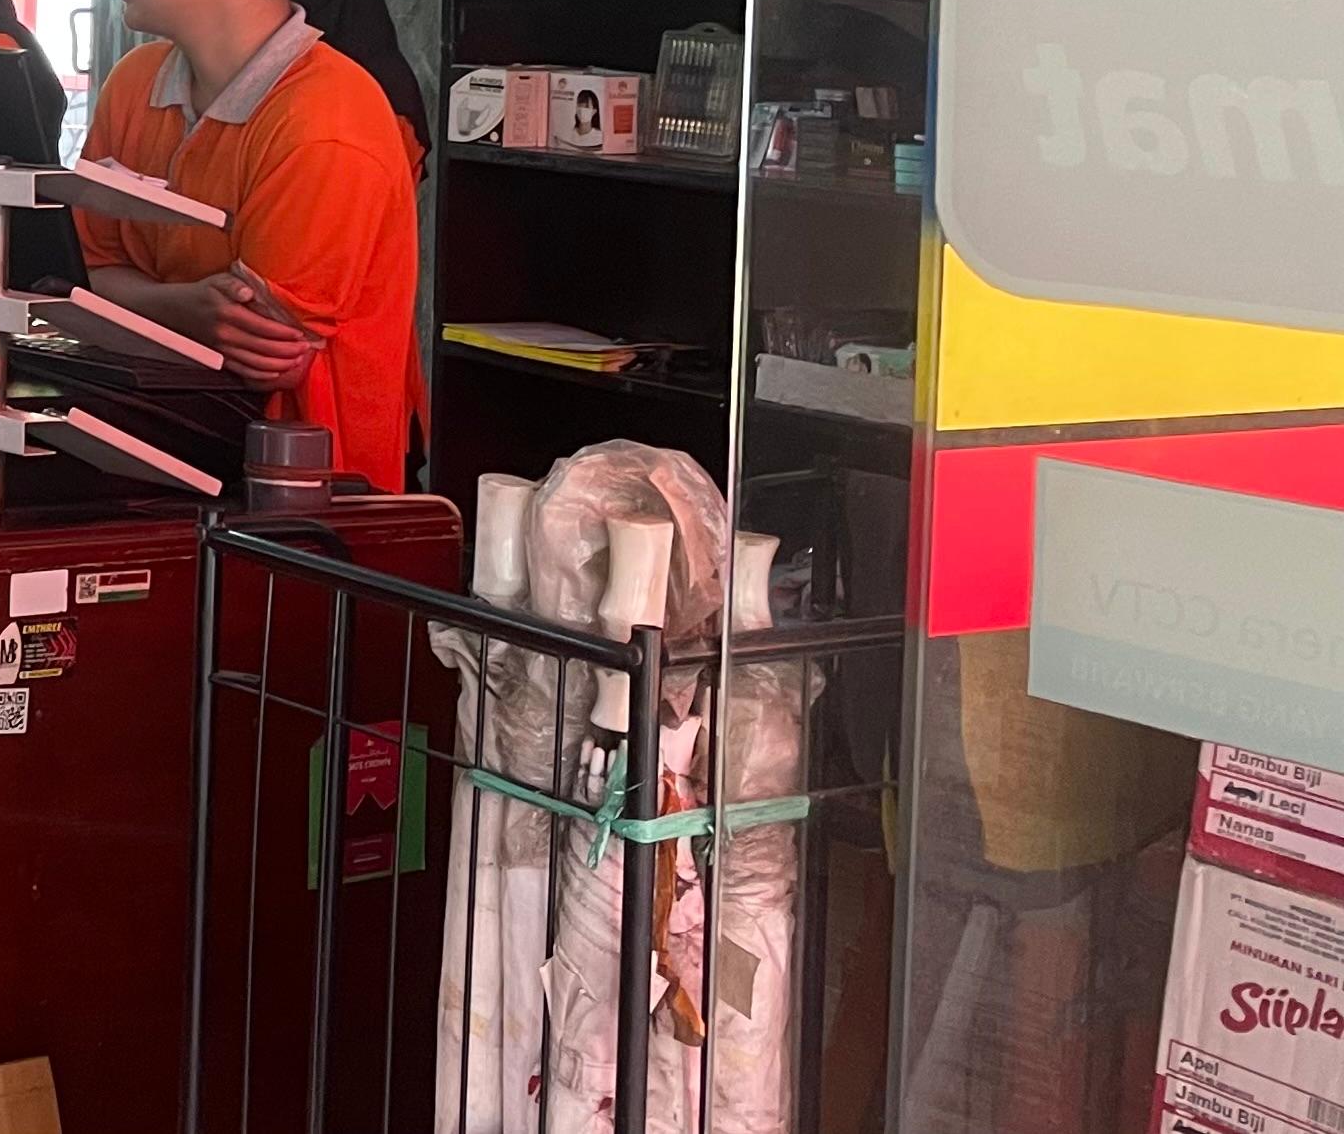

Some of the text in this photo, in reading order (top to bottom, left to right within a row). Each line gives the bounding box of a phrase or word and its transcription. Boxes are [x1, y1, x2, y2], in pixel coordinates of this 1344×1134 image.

[1229, 747, 1288, 776] Jambu
[1269, 793, 1307, 816] Leci
[1219, 814, 1275, 842] Nanas
[1230, 940, 1339, 989] MINUMAN SARI
[1180, 1050, 1219, 1077] Apel
[1175, 1085, 1233, 1118] Jambu
